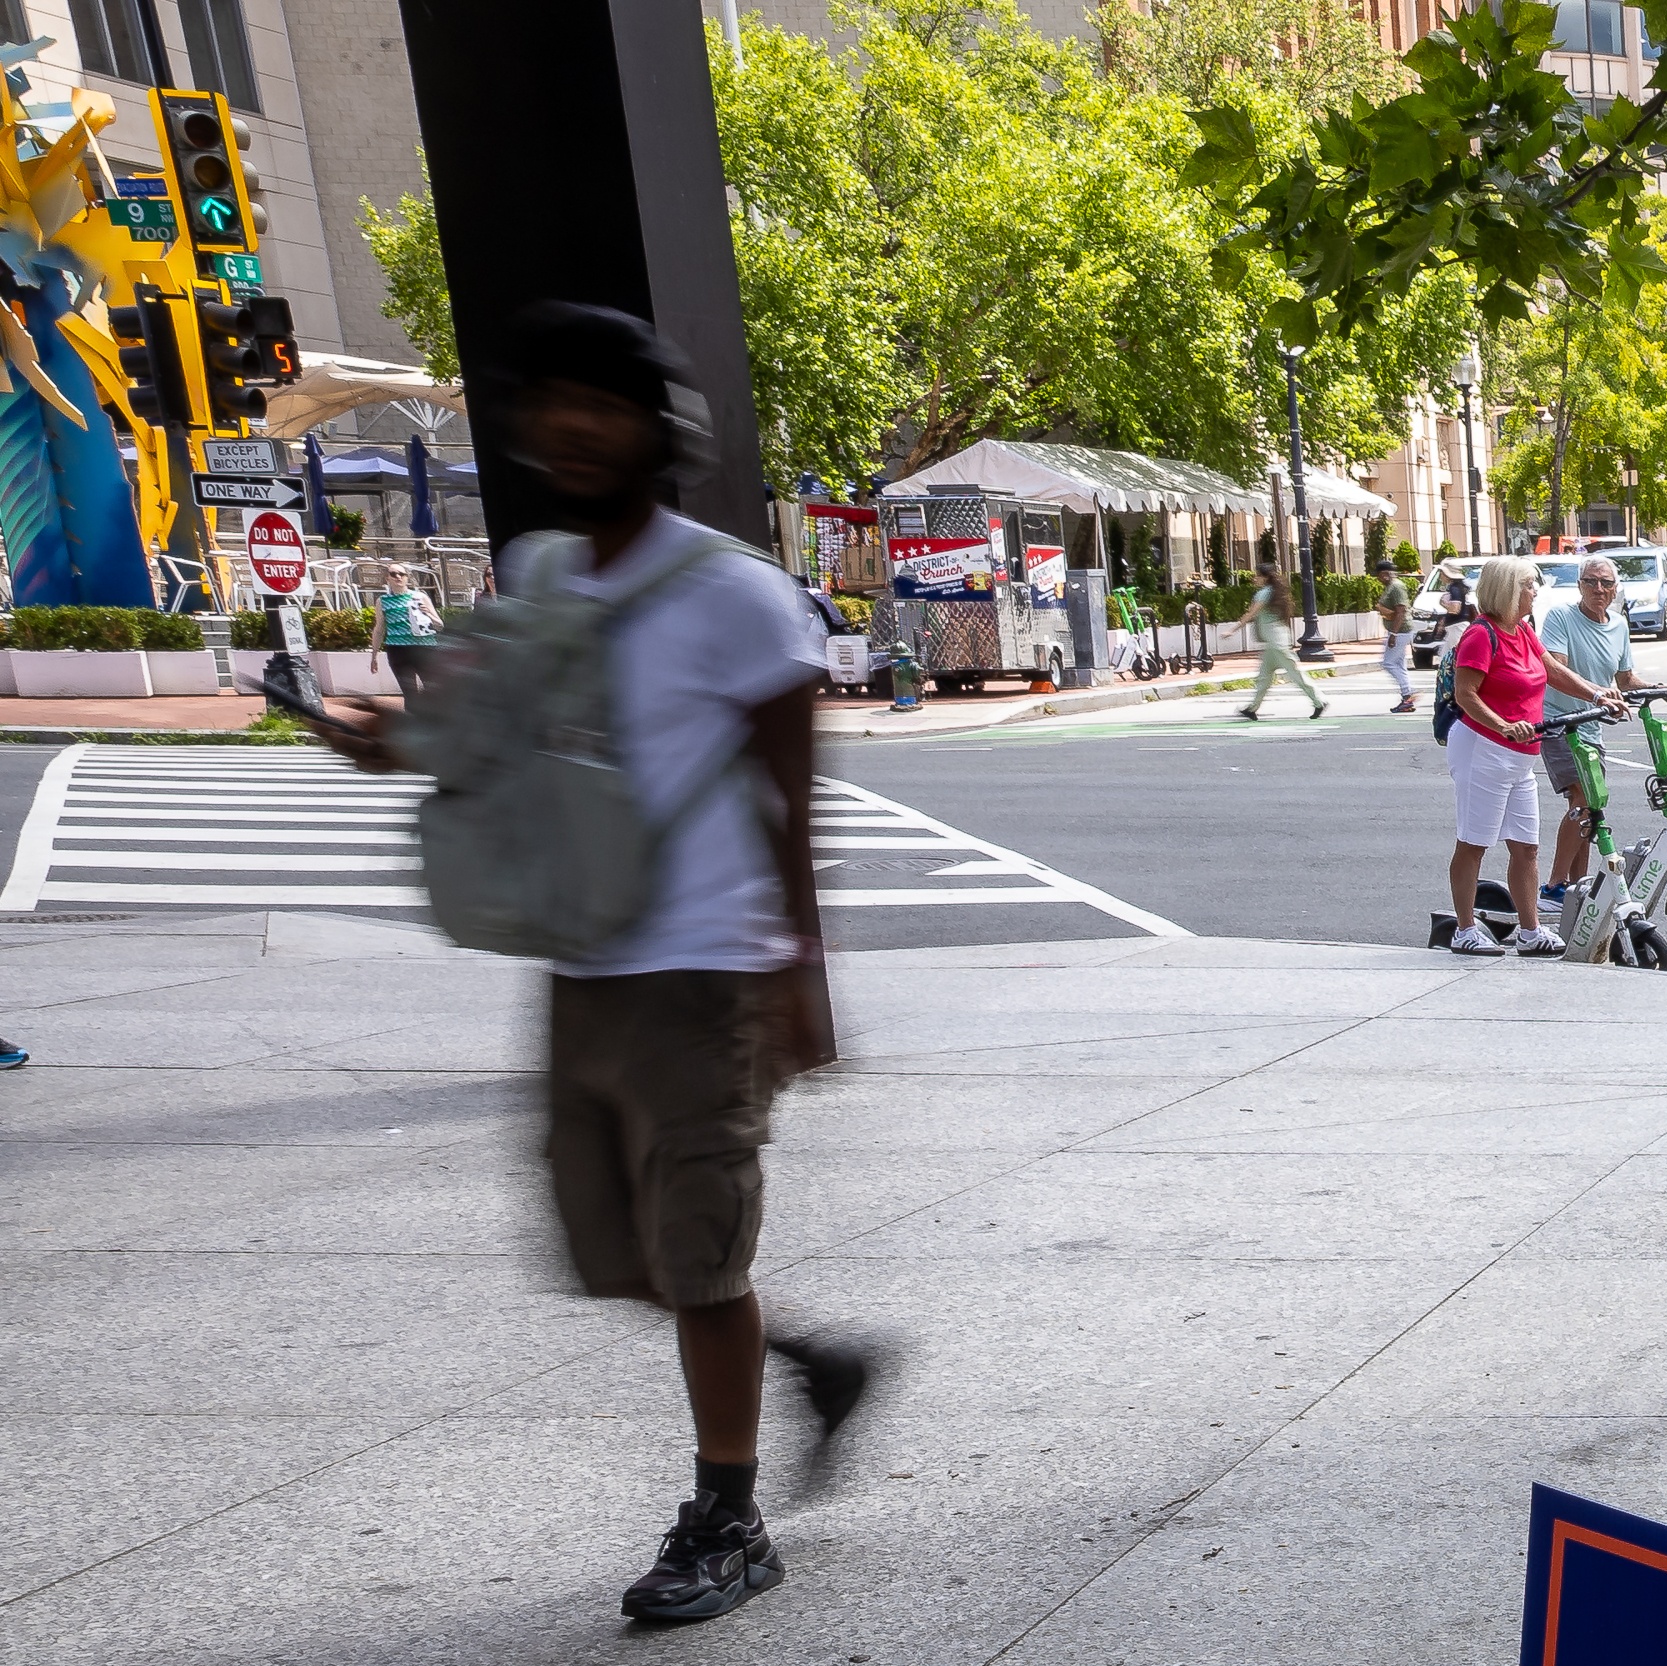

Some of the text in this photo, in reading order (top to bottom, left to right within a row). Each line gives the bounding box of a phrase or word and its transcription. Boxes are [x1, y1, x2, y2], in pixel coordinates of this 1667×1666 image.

[127, 203, 172, 223] 9 ST
[160, 214, 174, 223] NW
[132, 227, 171, 241] 700
[224, 257, 239, 278] G
[274, 342, 291, 373] 5
[216, 445, 260, 457] EXCEPT
[212, 458, 269, 470] BICYCLES
[205, 484, 272, 500] ONE WAY
[253, 526, 294, 543] DO NOT
[262, 563, 298, 579] ENTER
[912, 555, 950, 573] DISTRICT
[919, 564, 965, 581] Crunch
[1631, 858, 1663, 900] Lime
[1572, 902, 1600, 948] Lime
